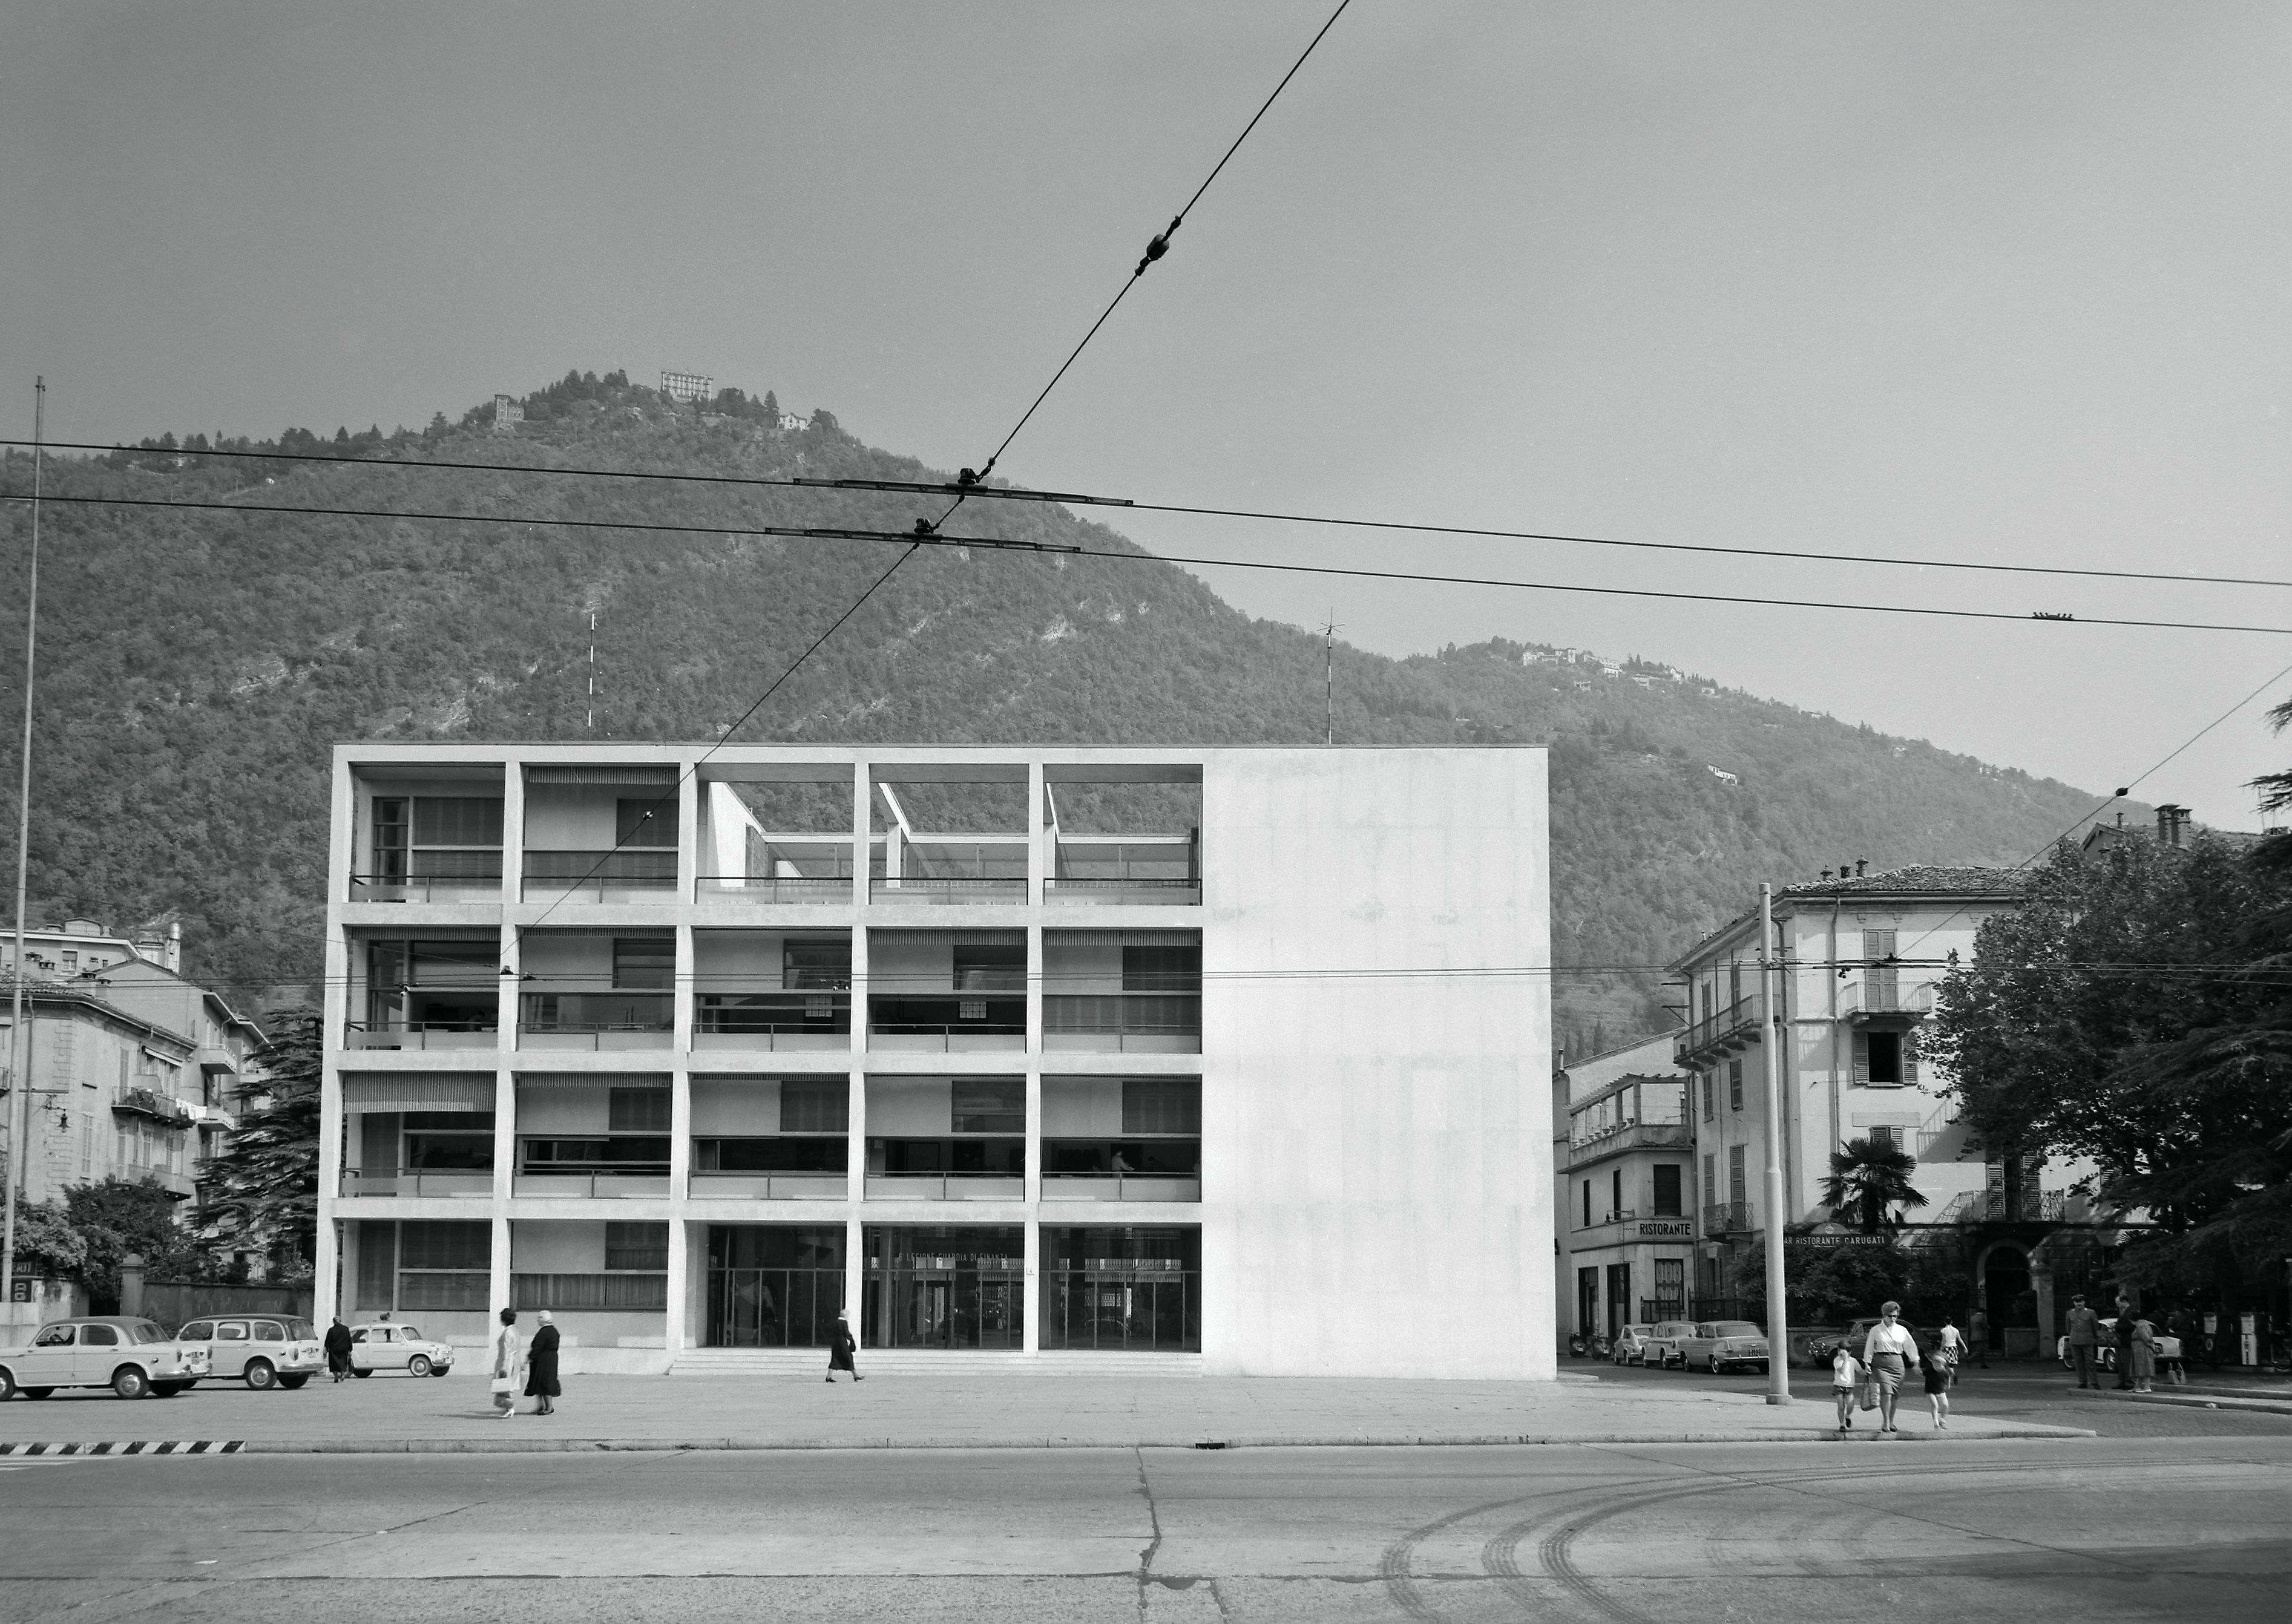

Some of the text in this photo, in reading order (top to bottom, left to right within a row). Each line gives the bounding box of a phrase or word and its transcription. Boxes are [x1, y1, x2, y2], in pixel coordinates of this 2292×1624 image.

[1640, 1223, 1690, 1235] RISTORANTE
[1796, 1237, 1840, 1245] RISTORANTE
[1845, 1236, 1885, 1245] CARUGATI
